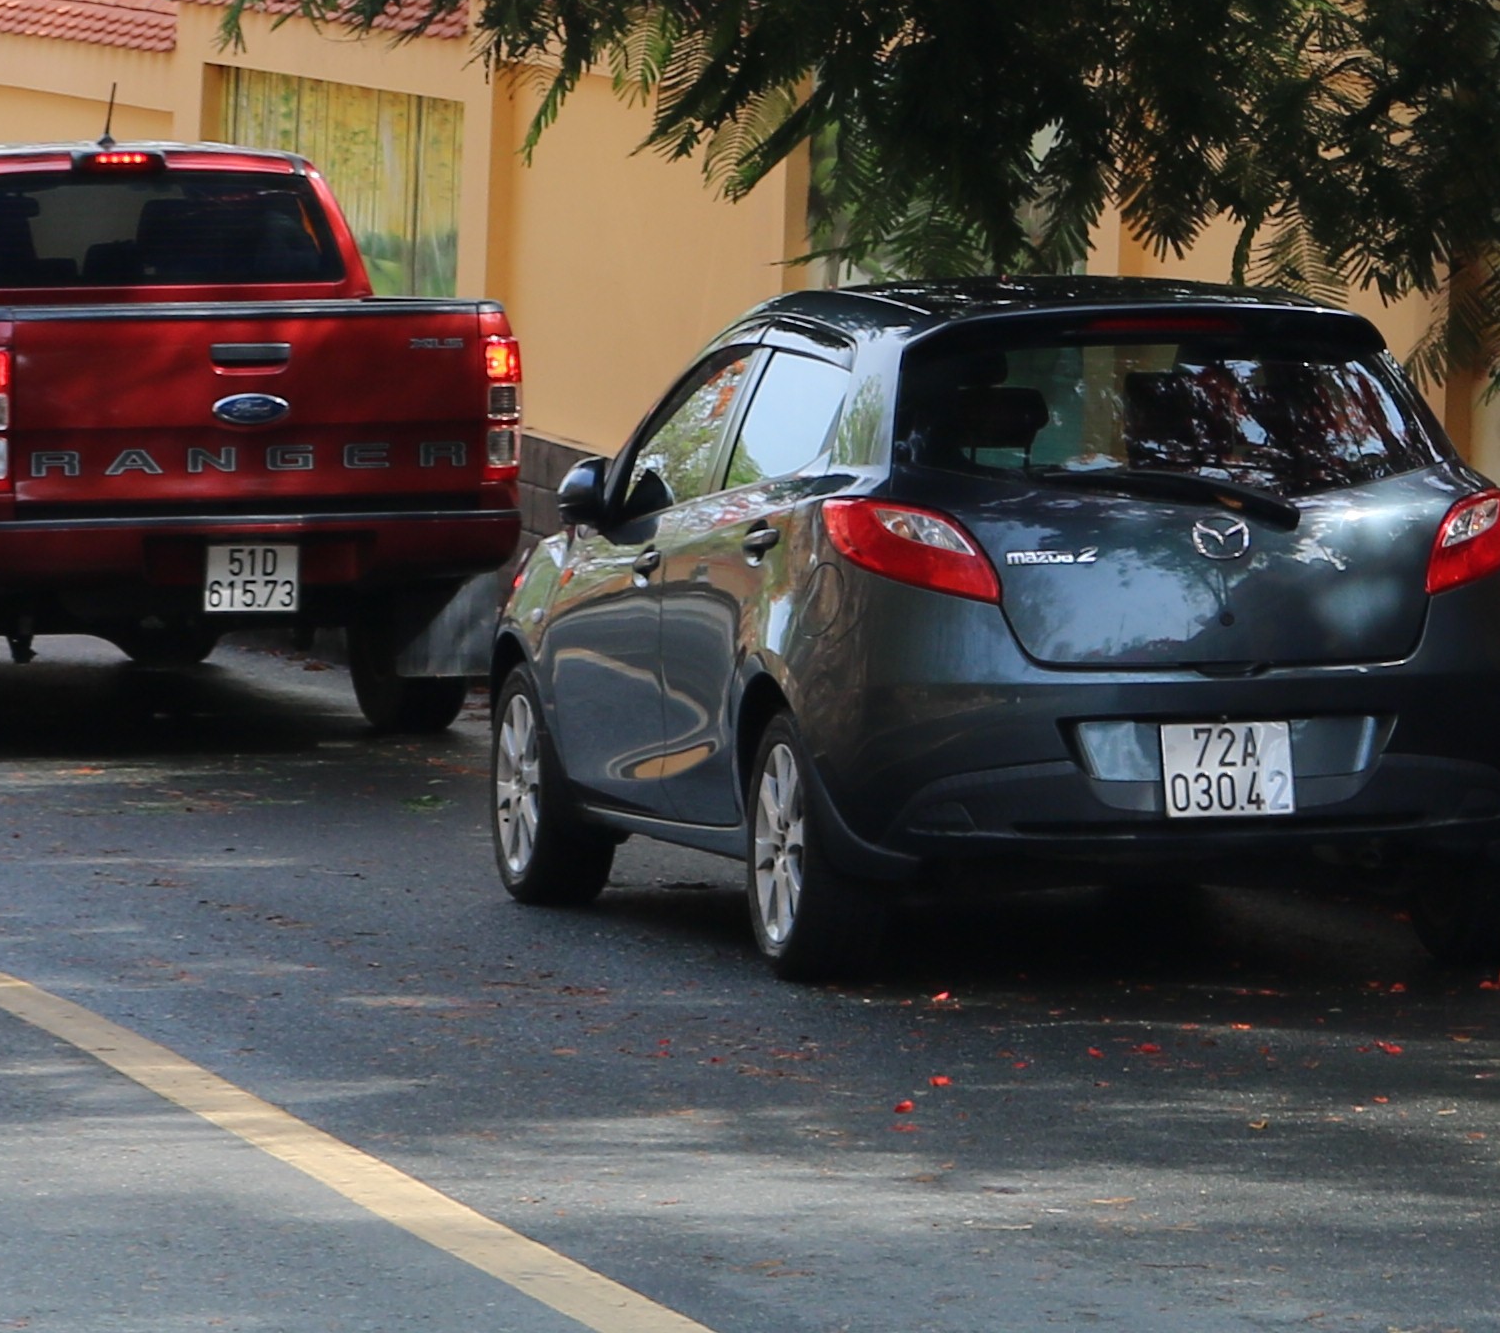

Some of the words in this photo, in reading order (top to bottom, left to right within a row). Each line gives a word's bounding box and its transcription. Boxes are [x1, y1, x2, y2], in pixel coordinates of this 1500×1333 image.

[31, 441, 466, 478] RANGER
[228, 547, 278, 577] 51D
[209, 579, 295, 608] 615.73
[1193, 726, 1260, 768] 72A
[1171, 769, 1290, 812] 030.42
